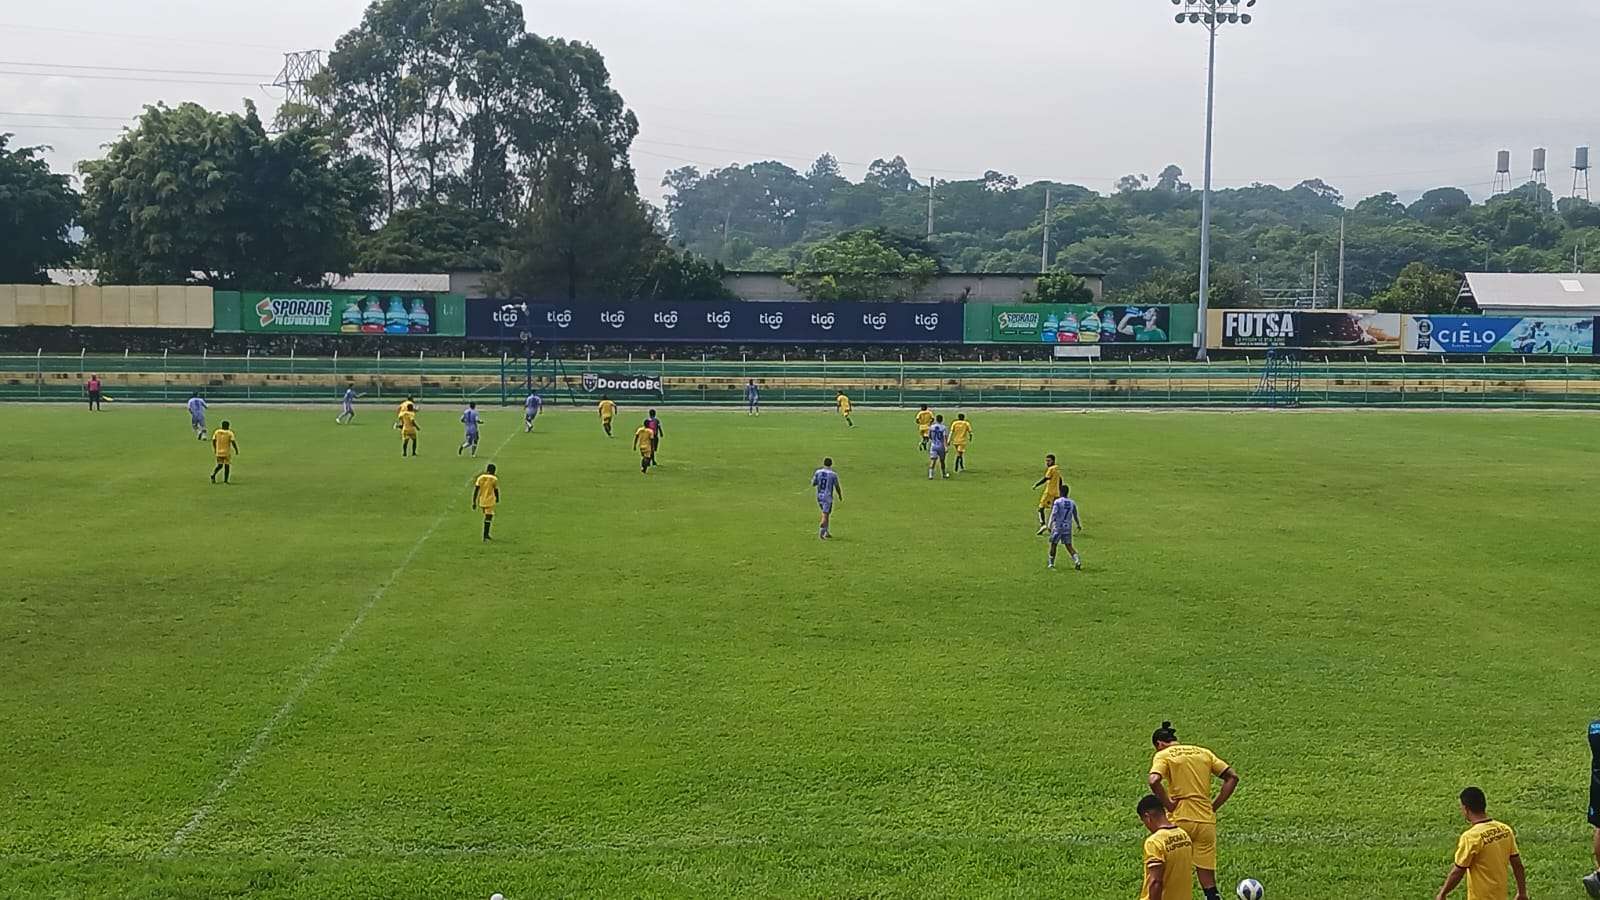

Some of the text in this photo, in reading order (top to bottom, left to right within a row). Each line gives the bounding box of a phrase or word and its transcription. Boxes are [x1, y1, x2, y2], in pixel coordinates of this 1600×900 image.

[271, 299, 331, 317] SPORADE
[1226, 313, 1294, 337] FUTSA
[1438, 330, 1496, 344] CIELO
